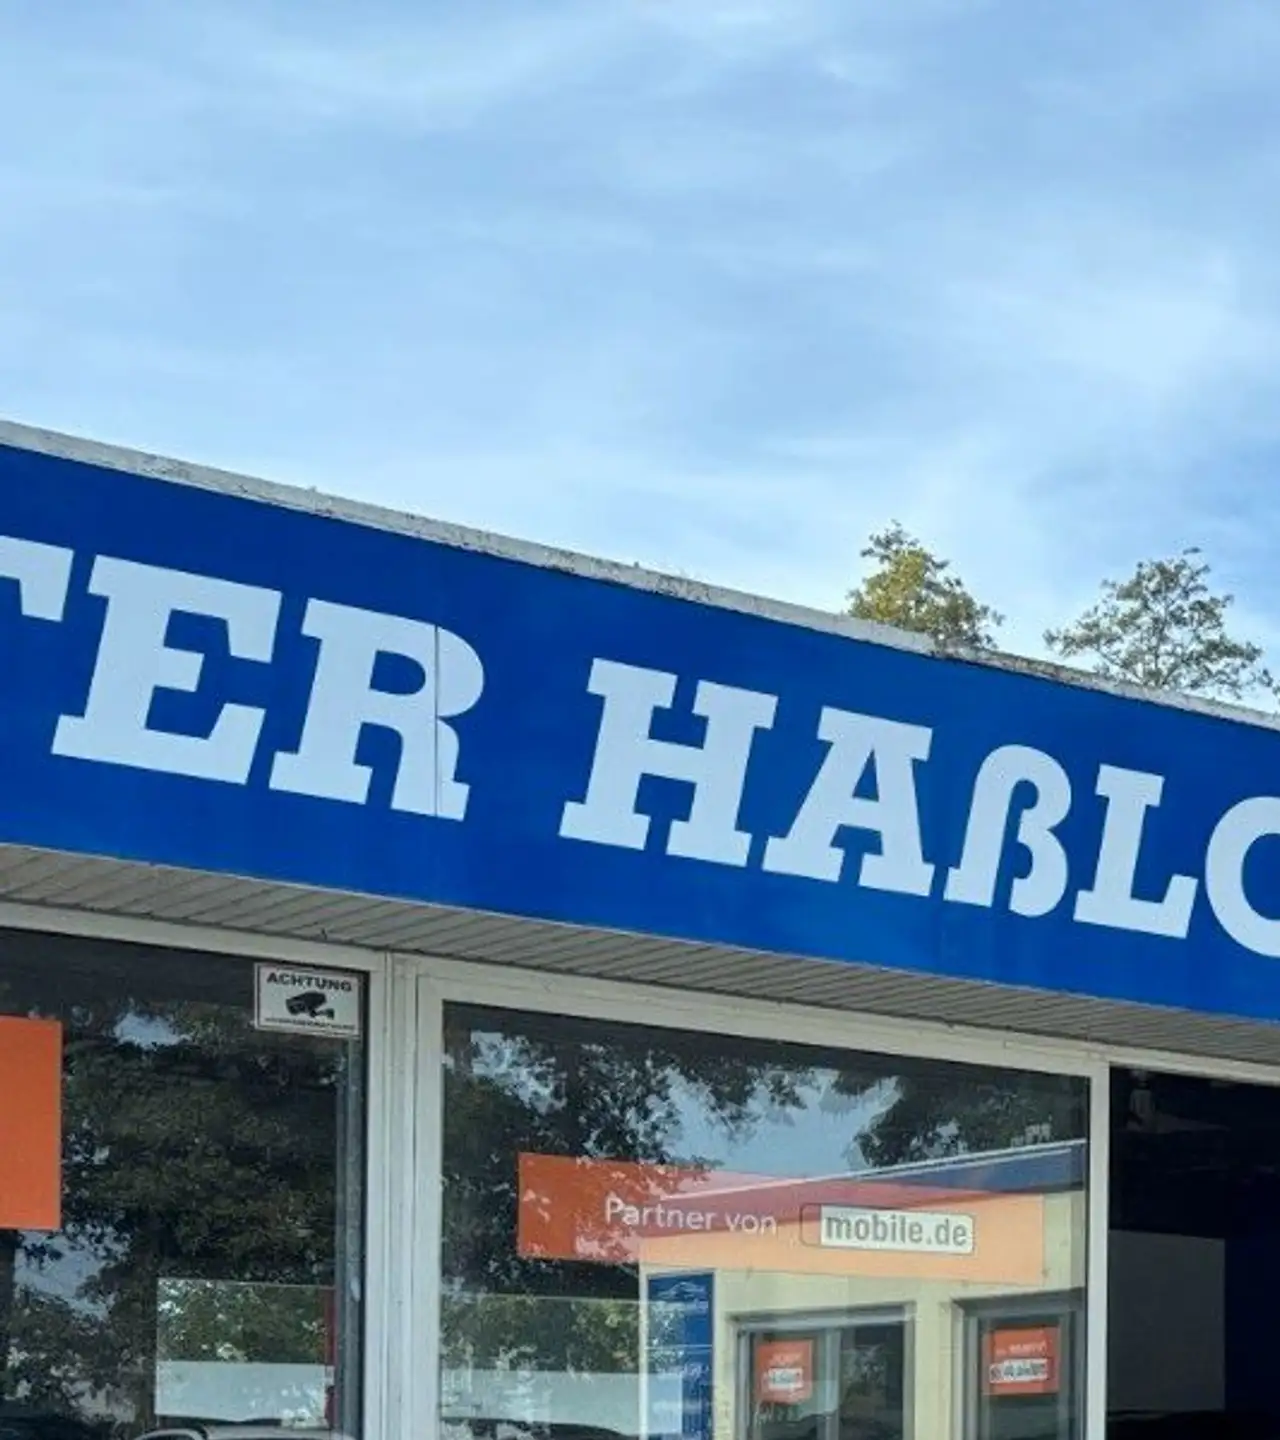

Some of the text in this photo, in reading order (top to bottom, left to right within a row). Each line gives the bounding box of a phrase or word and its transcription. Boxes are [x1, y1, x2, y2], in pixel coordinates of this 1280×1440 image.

[266, 972, 352, 992] ACHTUNG
[605, 1197, 776, 1236] Partner von
[825, 1210, 968, 1248] mobile.de
